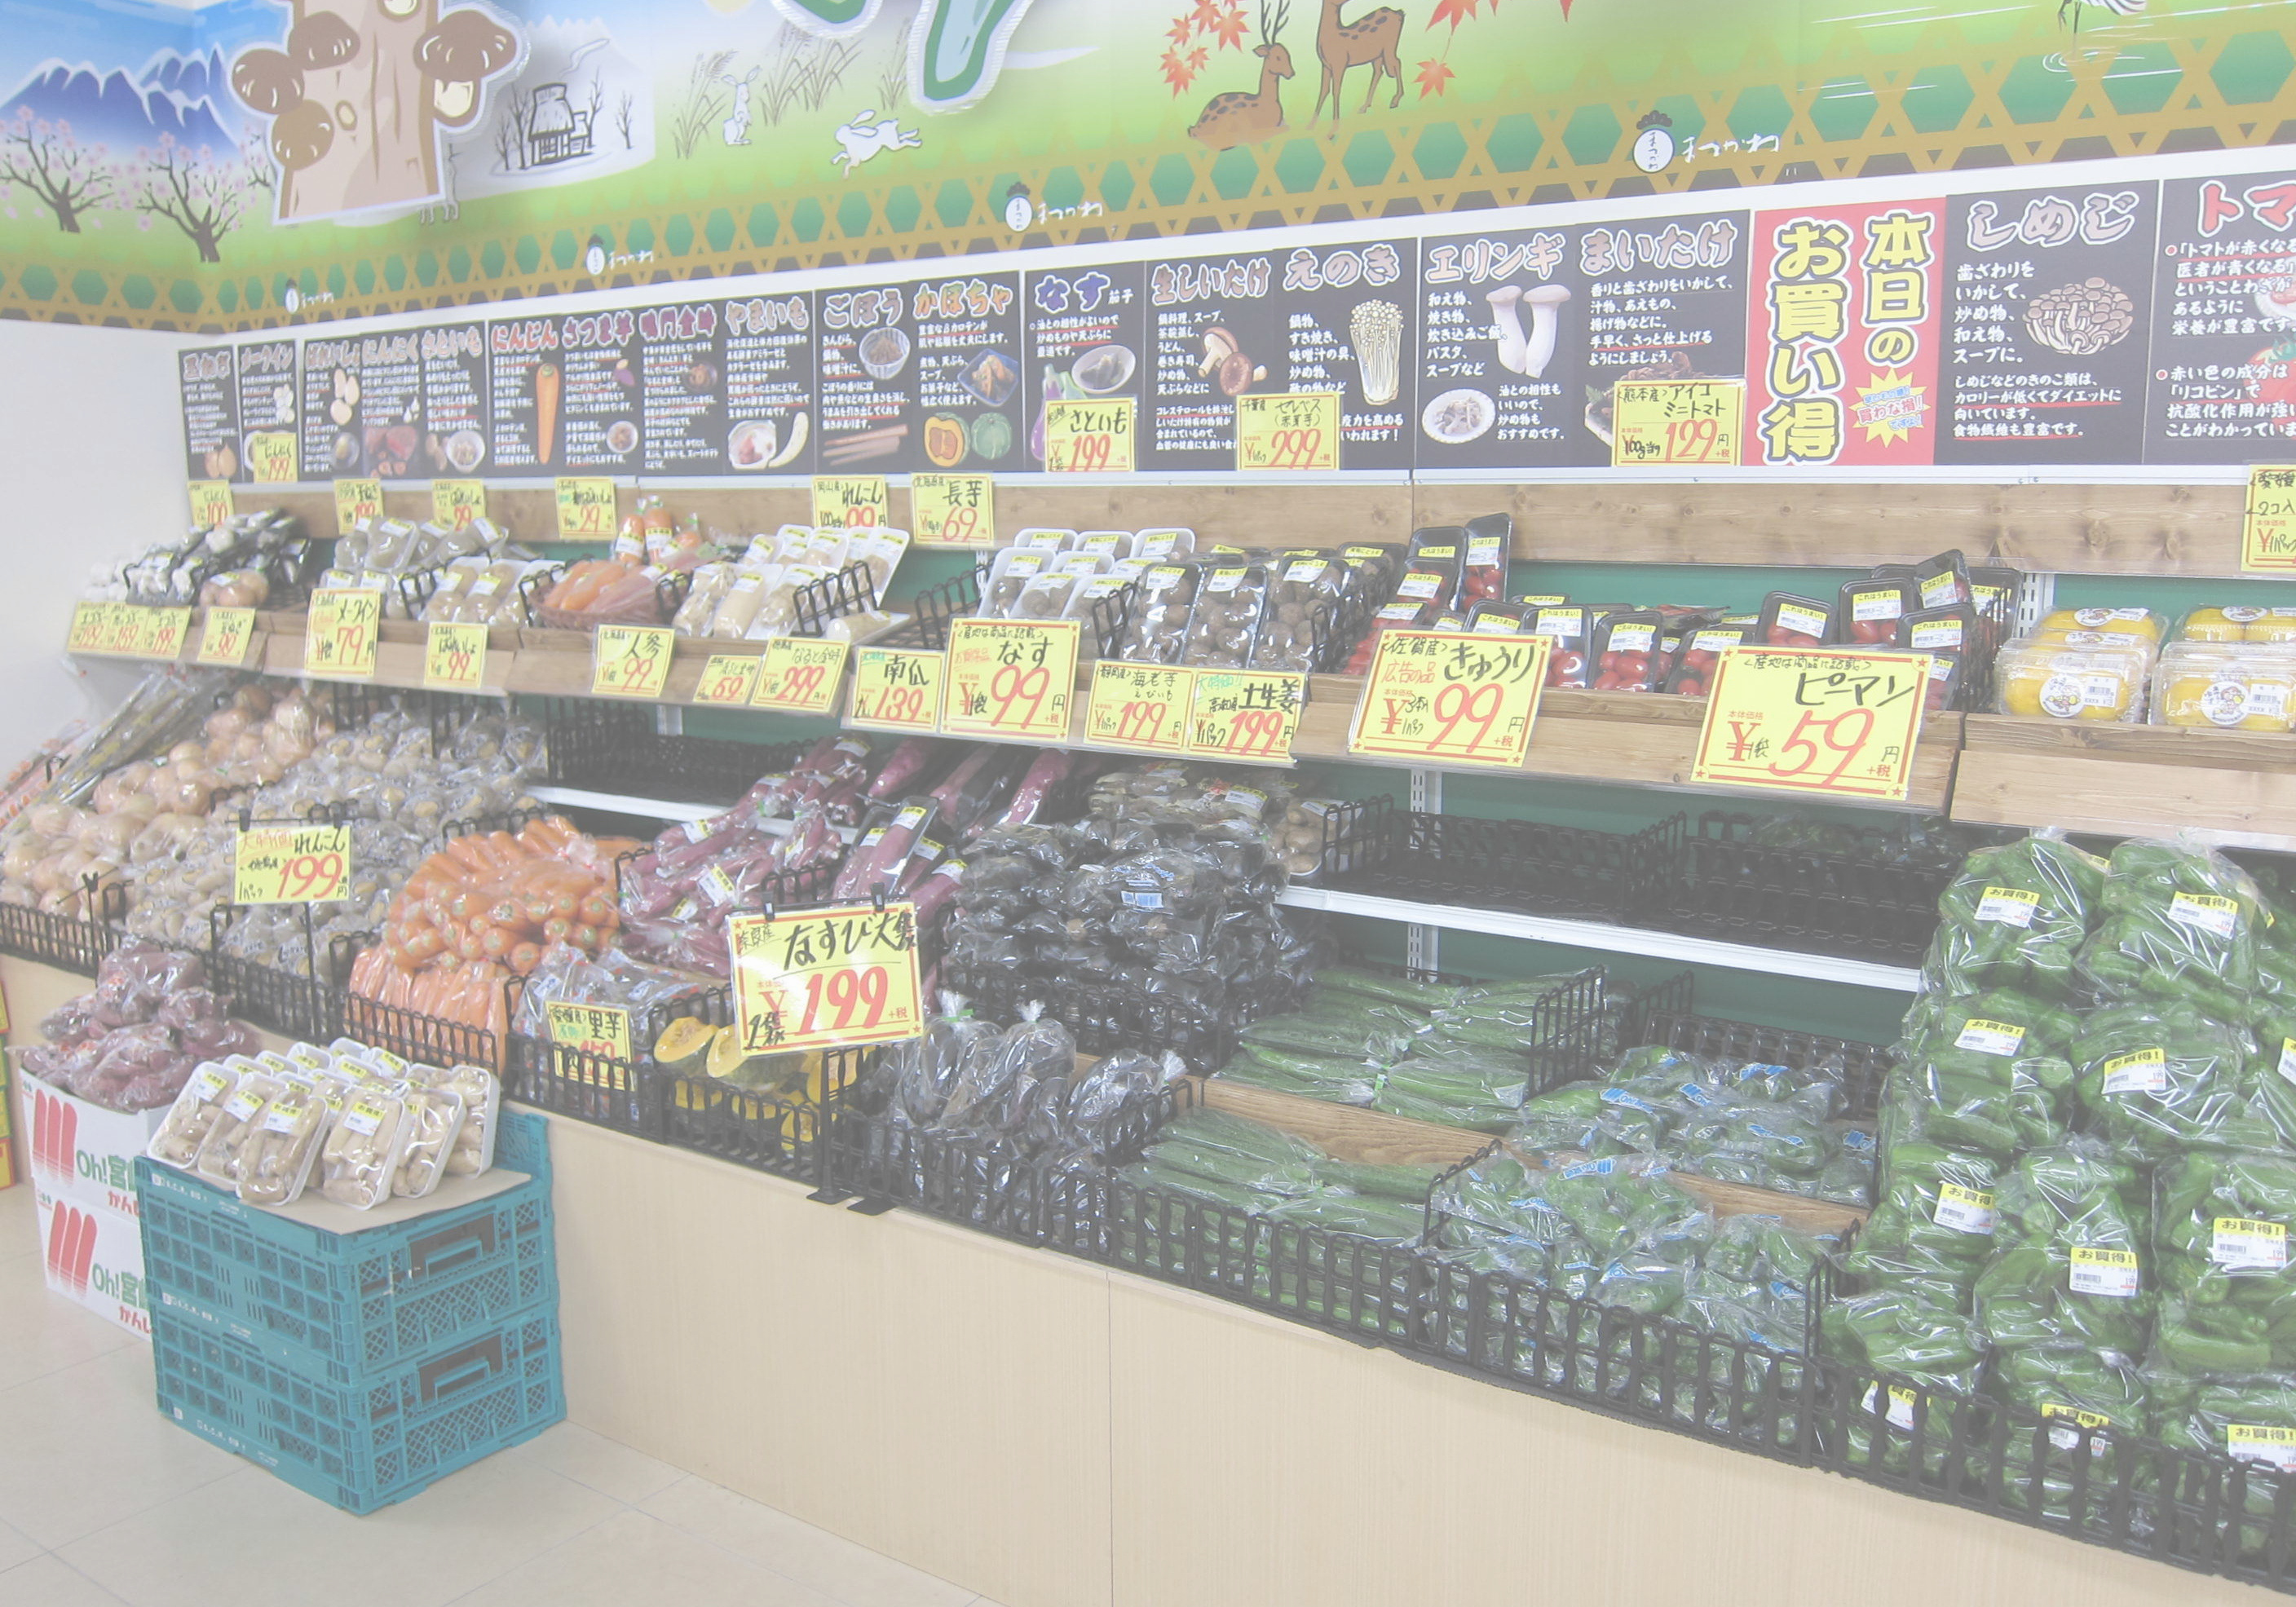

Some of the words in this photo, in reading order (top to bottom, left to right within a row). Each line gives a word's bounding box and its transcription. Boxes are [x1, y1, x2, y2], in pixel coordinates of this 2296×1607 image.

[1967, 191, 2139, 252] しめじ
[1580, 219, 1738, 276] まいたけ
[1283, 244, 1400, 291] えのき
[1425, 232, 1565, 285] エリンギ
[1957, 261, 2035, 282] 歯ざわりを
[1151, 257, 1271, 306] 生しいたけ
[1590, 275, 1734, 298] 香りと歯ざわりをいかして、
[1859, 209, 1935, 368] 本日の
[2175, 279, 2291, 297] ということわざが
[913, 278, 1013, 318] かぼちゃ
[1035, 271, 1111, 314] なす
[1428, 291, 1473, 307] 和え物、
[1955, 283, 2027, 302] いかして、
[725, 295, 810, 336] やまいも
[823, 288, 903, 329] ごぼう
[1590, 298, 1678, 314] 汁物、あえもの、
[1954, 305, 2016, 322] 炒め物、
[2173, 299, 2244, 316] あるように
[1427, 308, 1472, 325] 焼き物、
[1590, 315, 1668, 331] 揚げ物などに。
[491, 319, 559, 355] にんじん
[1288, 331, 1339, 346] すき焼き、
[1426, 324, 1508, 343] 炊き込みご飯、
[1589, 330, 1713, 349] 手早く、さっと仕上げる
[1756, 216, 1854, 466] お買い得
[1954, 326, 2014, 343] 和え物、
[1157, 342, 1186, 353] うどん、
[1288, 347, 1356, 362] 味噌汁の具、
[1426, 346, 1468, 360] パスタ、
[1952, 346, 2024, 364] スープに。
[1588, 350, 1675, 367] ようにしましょう。
[1288, 364, 1331, 380] 炒め物、
[1425, 362, 1486, 378] スープなど
[2170, 364, 2288, 382] 赤い色の成分は
[1156, 382, 1210, 396] 天ぷらなどに
[1955, 372, 2100, 388] しめじなどのきのこ類は、
[1498, 383, 1562, 398] 油との相性も
[1669, 382, 1711, 400] アイコ
[1954, 387, 2122, 404] カロリーが低くてダイエットに
[1498, 399, 1545, 412] いいので、
[1664, 399, 1726, 418] ミニトマト
[1954, 408, 2036, 422] 向いています。
[1070, 407, 1127, 434] さといも
[1497, 413, 1541, 426] 炒め物も
[1497, 426, 1565, 441] おすすめです。
[1717, 434, 1729, 446] 円
[1954, 422, 2084, 439] 食物繊維も豊富です。
[1269, 429, 1322, 470] 299
[1665, 419, 1718, 462] 129
[1067, 434, 1111, 472] 199
[943, 480, 982, 507] 長芋
[942, 506, 978, 543] 69
[2257, 528, 2274, 553] ¥
[337, 625, 364, 666] 79
[623, 632, 665, 659] 人参
[996, 637, 1054, 670] なす
[448, 651, 470, 681] 99
[1381, 659, 1436, 685] 広告の品
[1444, 642, 1535, 683] きゅうり
[621, 658, 653, 691] 99
[1130, 671, 1178, 687] 海老芋
[775, 665, 826, 706] 299
[1795, 672, 1915, 707] ピーマン
[873, 687, 923, 723] 139
[991, 664, 1051, 730] 99
[1052, 694, 1066, 712] 円
[1117, 701, 1166, 744] 199
[1380, 698, 1411, 735] ¥
[1426, 683, 1504, 753] 99
[1508, 717, 1526, 733] 円
[1728, 710, 1764, 721] 本体価格
[1225, 711, 1284, 757] 199
[1283, 726, 1295, 739] 円
[1494, 736, 1513, 748] +税
[1725, 721, 1761, 762] ¥
[1768, 708, 1875, 788] 59
[1880, 746, 1901, 764] 円
[1866, 764, 1891, 777] +税
[276, 853, 343, 899] 199
[1989, 888, 2036, 903] お買得!
[794, 965, 889, 1036] 199
[889, 1006, 907, 1019] +税
[1971, 1019, 2022, 1035] お買得!
[2110, 1050, 2161, 1068] お買得!
[2220, 1219, 2281, 1236] お買得!
[2078, 1248, 2134, 1265] お買得!
